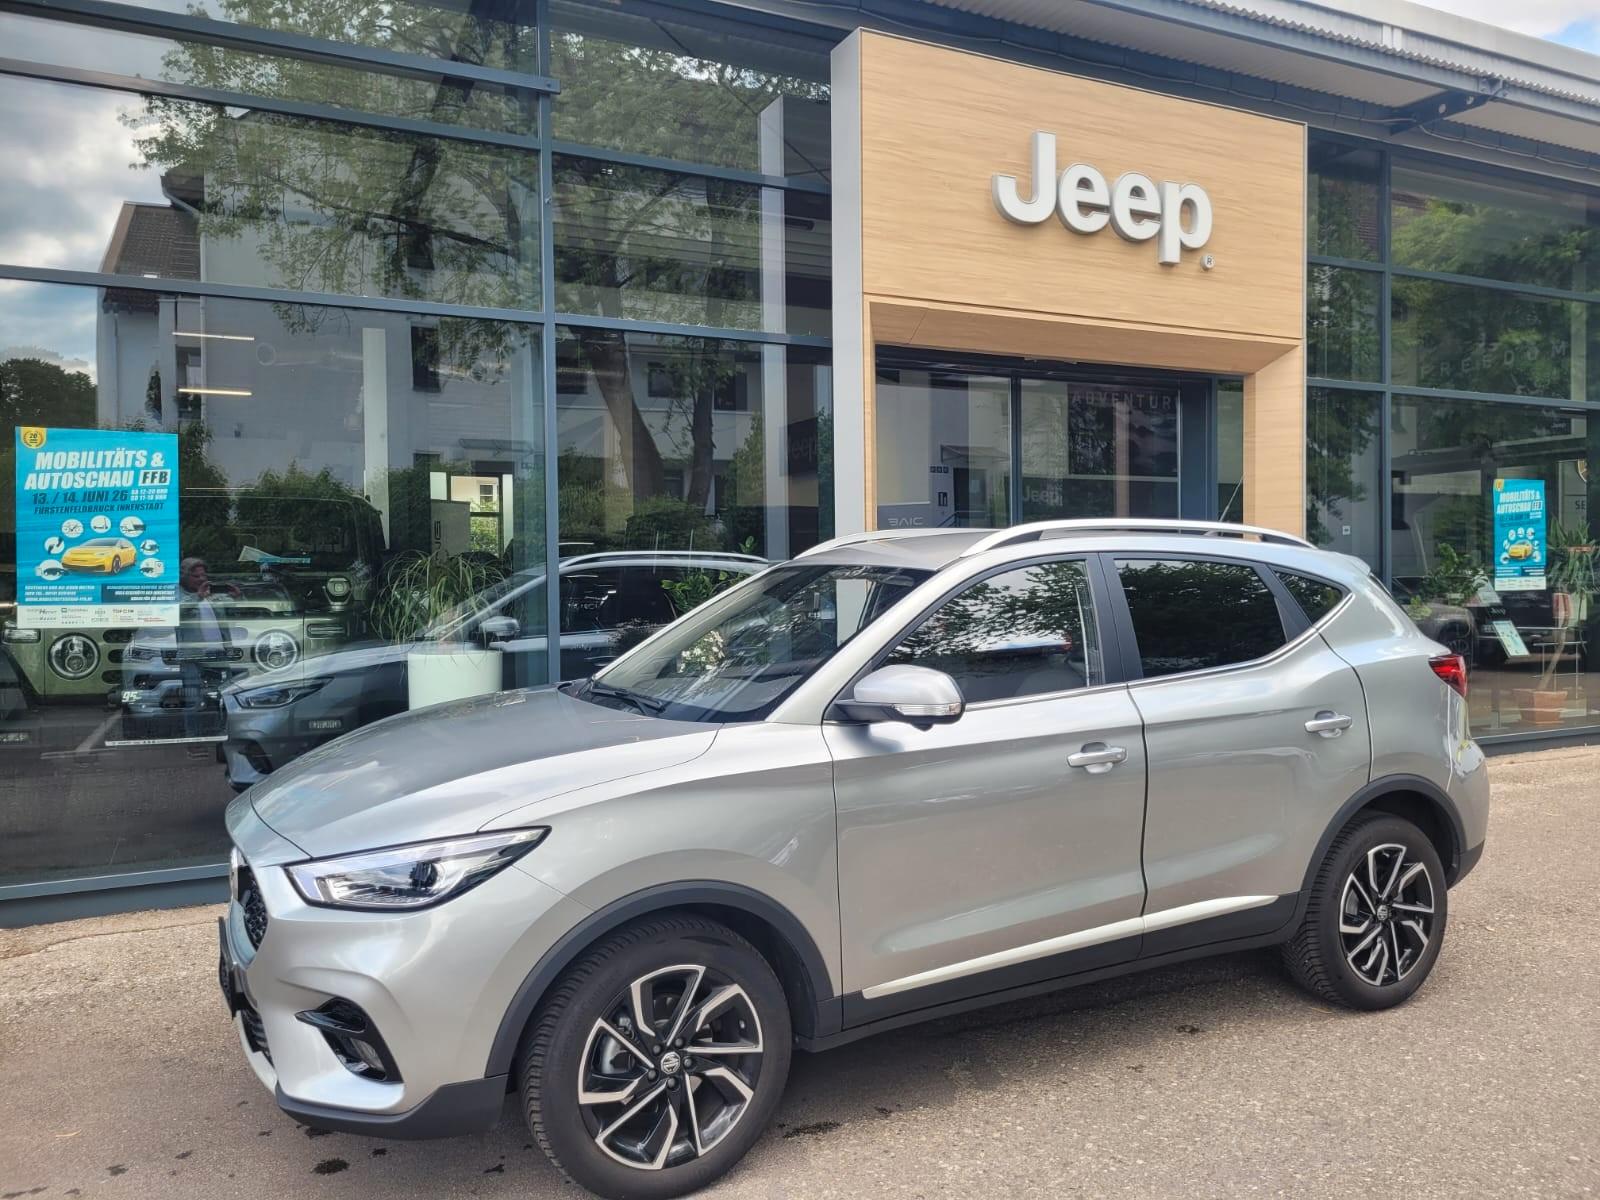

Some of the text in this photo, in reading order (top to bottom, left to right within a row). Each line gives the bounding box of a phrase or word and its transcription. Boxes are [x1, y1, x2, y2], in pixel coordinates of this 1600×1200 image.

[992, 130, 1213, 265] Jeep
[1420, 342, 1568, 378] FREEDOM
[1071, 391, 1178, 409] ADVENTUR
[35, 448, 165, 470] MOBILITÄTS &
[24, 470, 169, 490] AUTOSCHAU FFB
[32, 493, 48, 504] 13.
[62, 491, 79, 503] 14.
[82, 490, 109, 502] JUNI
[112, 489, 129, 502] 26
[117, 503, 164, 512] INNENSTADT
